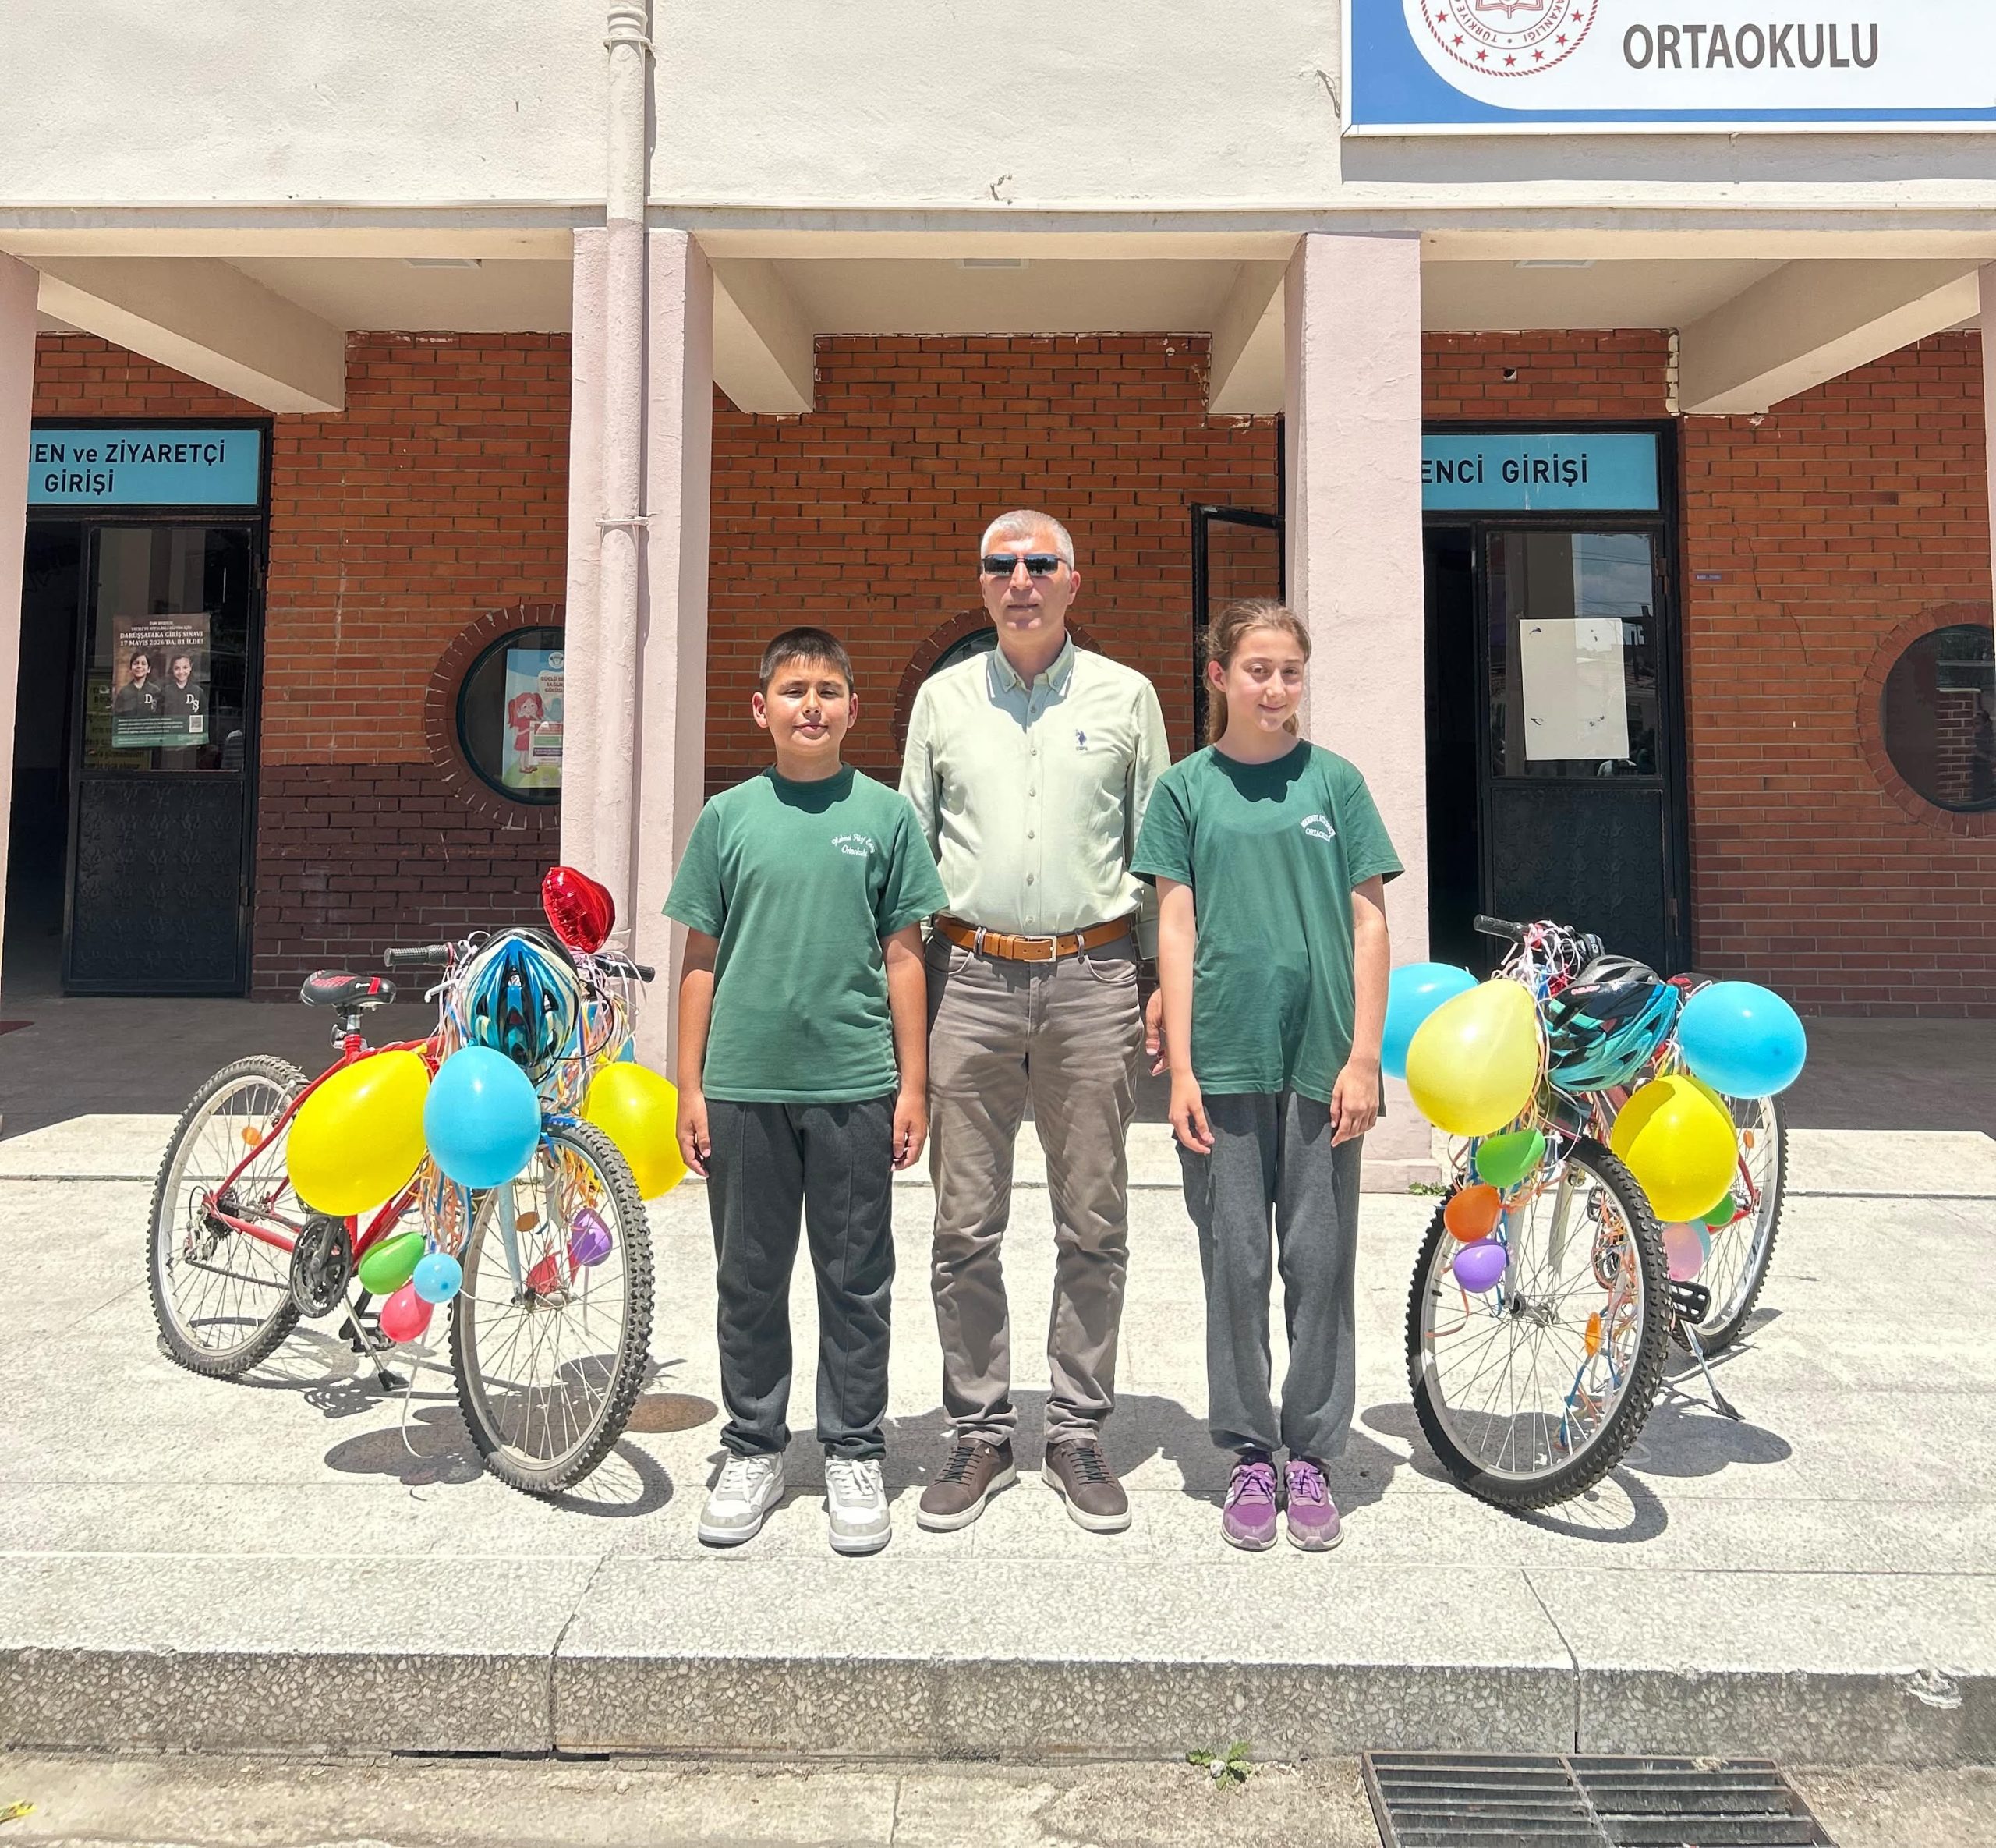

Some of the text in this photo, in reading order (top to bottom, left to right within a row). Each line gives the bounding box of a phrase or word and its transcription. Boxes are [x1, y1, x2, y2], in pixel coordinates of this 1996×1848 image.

[1623, 23, 1878, 69] ORTAOKULU
[73, 447, 97, 462] ve
[105, 439, 225, 466] ZİYARETÇİ
[44, 469, 114, 495] GİRİŞİ
[1502, 453, 1587, 487] GİRİŞİ
